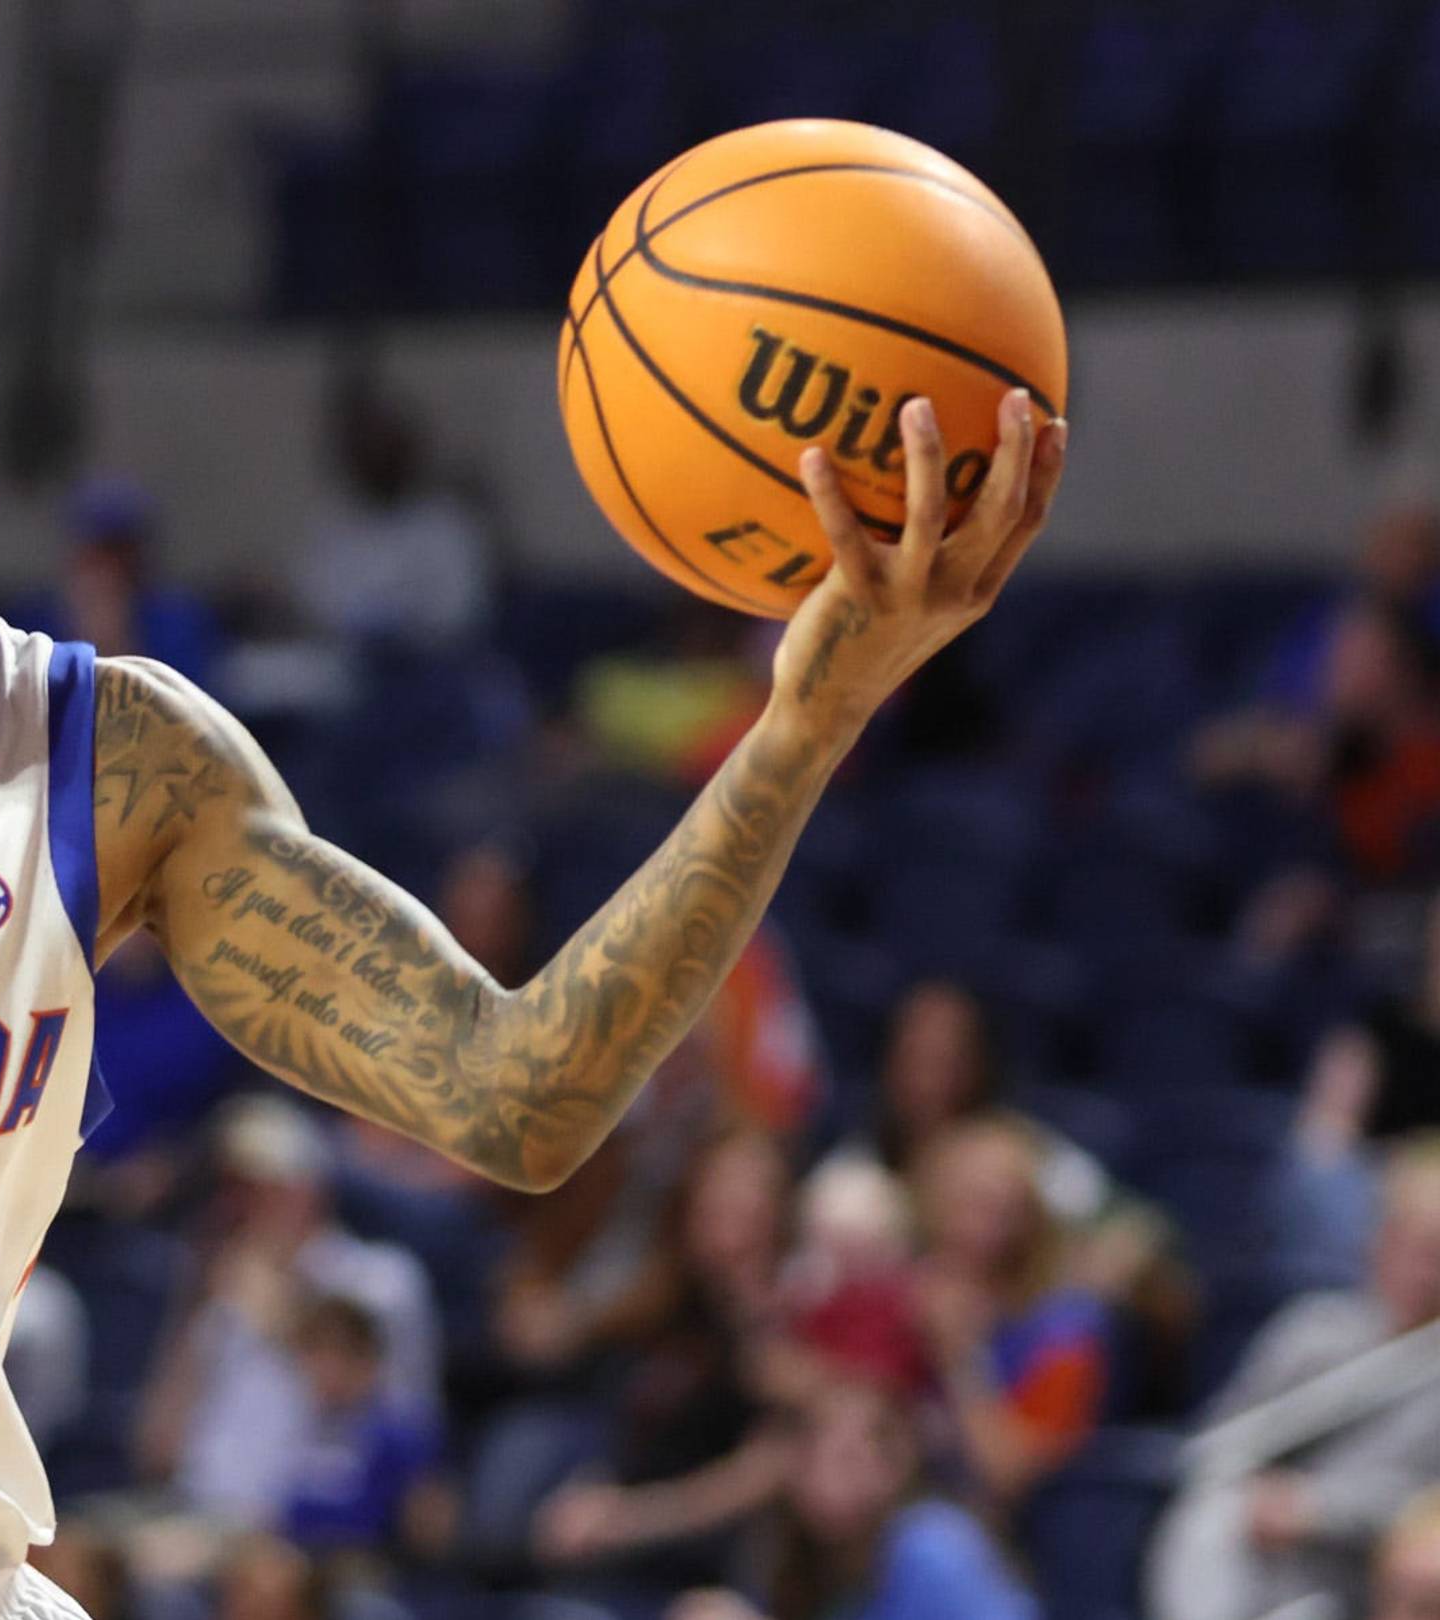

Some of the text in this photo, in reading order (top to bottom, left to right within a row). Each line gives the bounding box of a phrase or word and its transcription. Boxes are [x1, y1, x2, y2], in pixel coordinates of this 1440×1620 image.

[738, 324, 991, 497] Wilo
[203, 867, 257, 909] If
[231, 890, 288, 924] you
[288, 911, 356, 962] don't
[295, 989, 339, 1026] who
[339, 1022, 397, 1057] will
